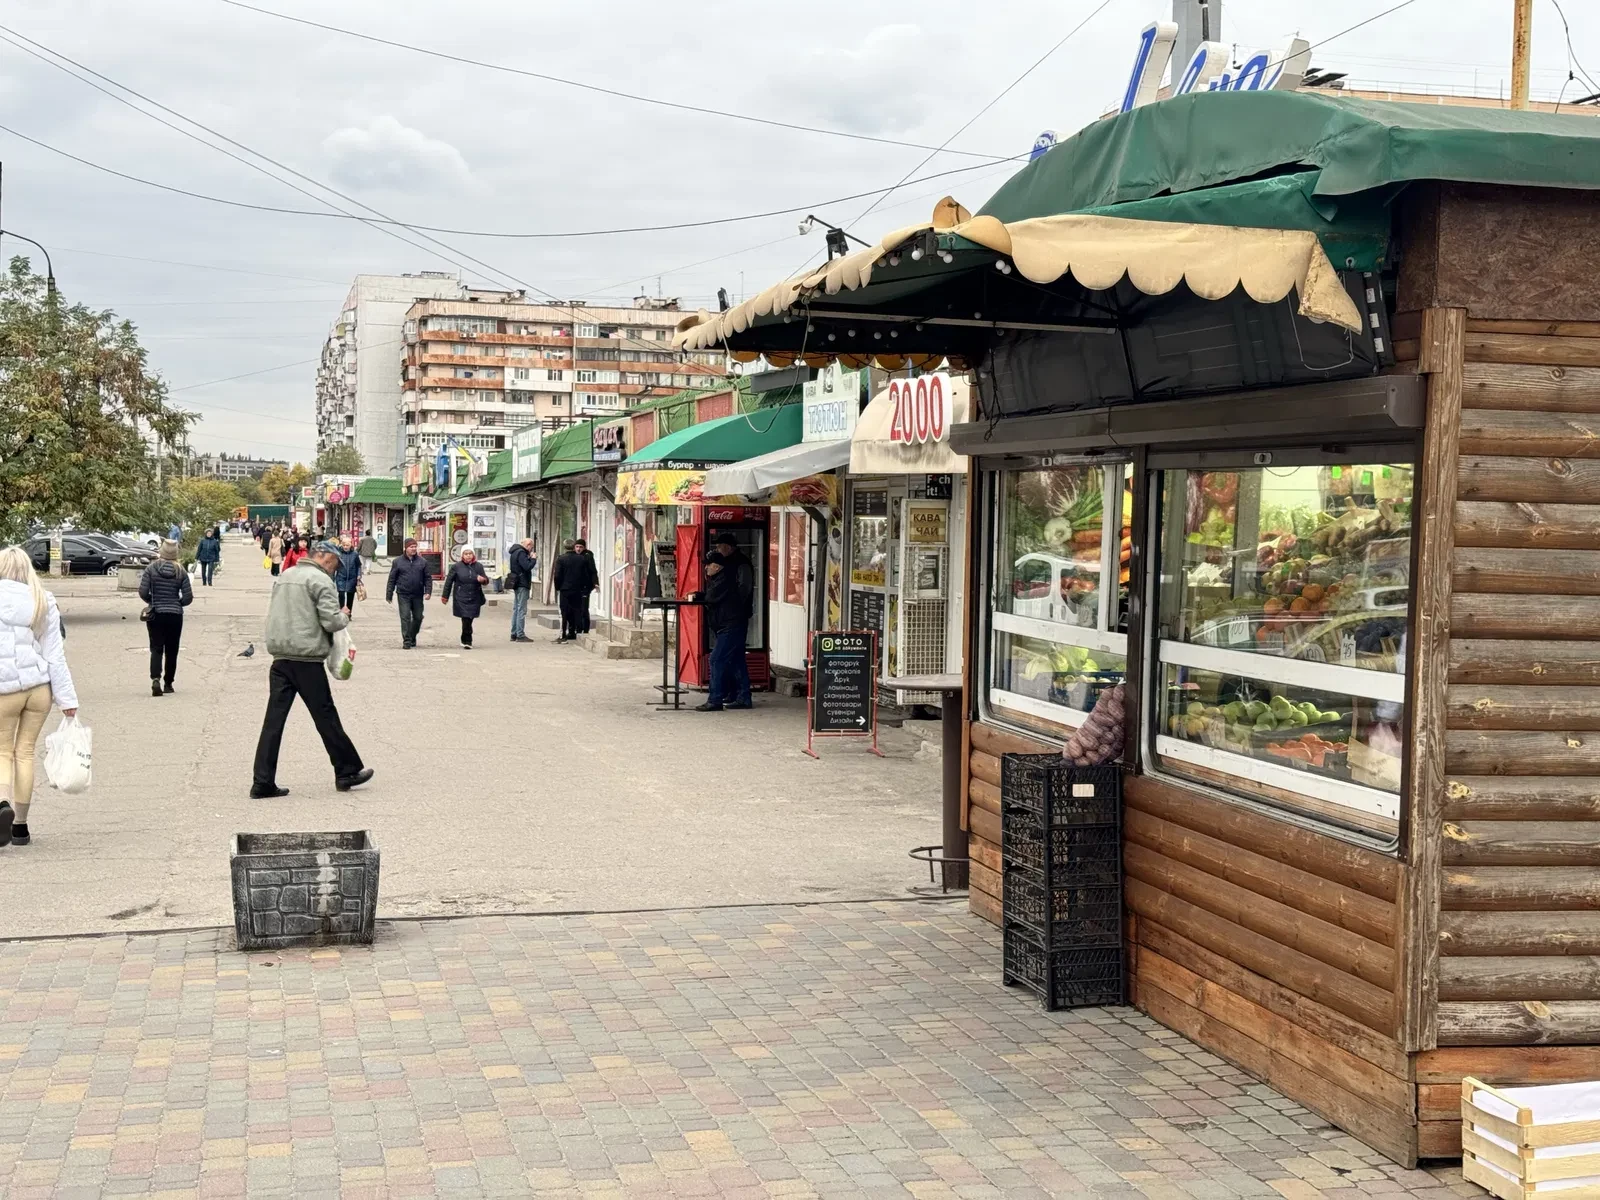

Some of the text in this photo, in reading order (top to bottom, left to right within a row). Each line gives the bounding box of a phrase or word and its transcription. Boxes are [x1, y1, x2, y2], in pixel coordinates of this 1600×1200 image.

[889, 375, 944, 443] 2000
[808, 401, 848, 433] ТЮТЮН
[667, 460, 694, 470] бургер
[376, 507, 385, 539] ОДЯГ
[913, 513, 941, 523] КАВА
[916, 526, 939, 536] ЧАЙ
[834, 638, 863, 646] ФОТО
